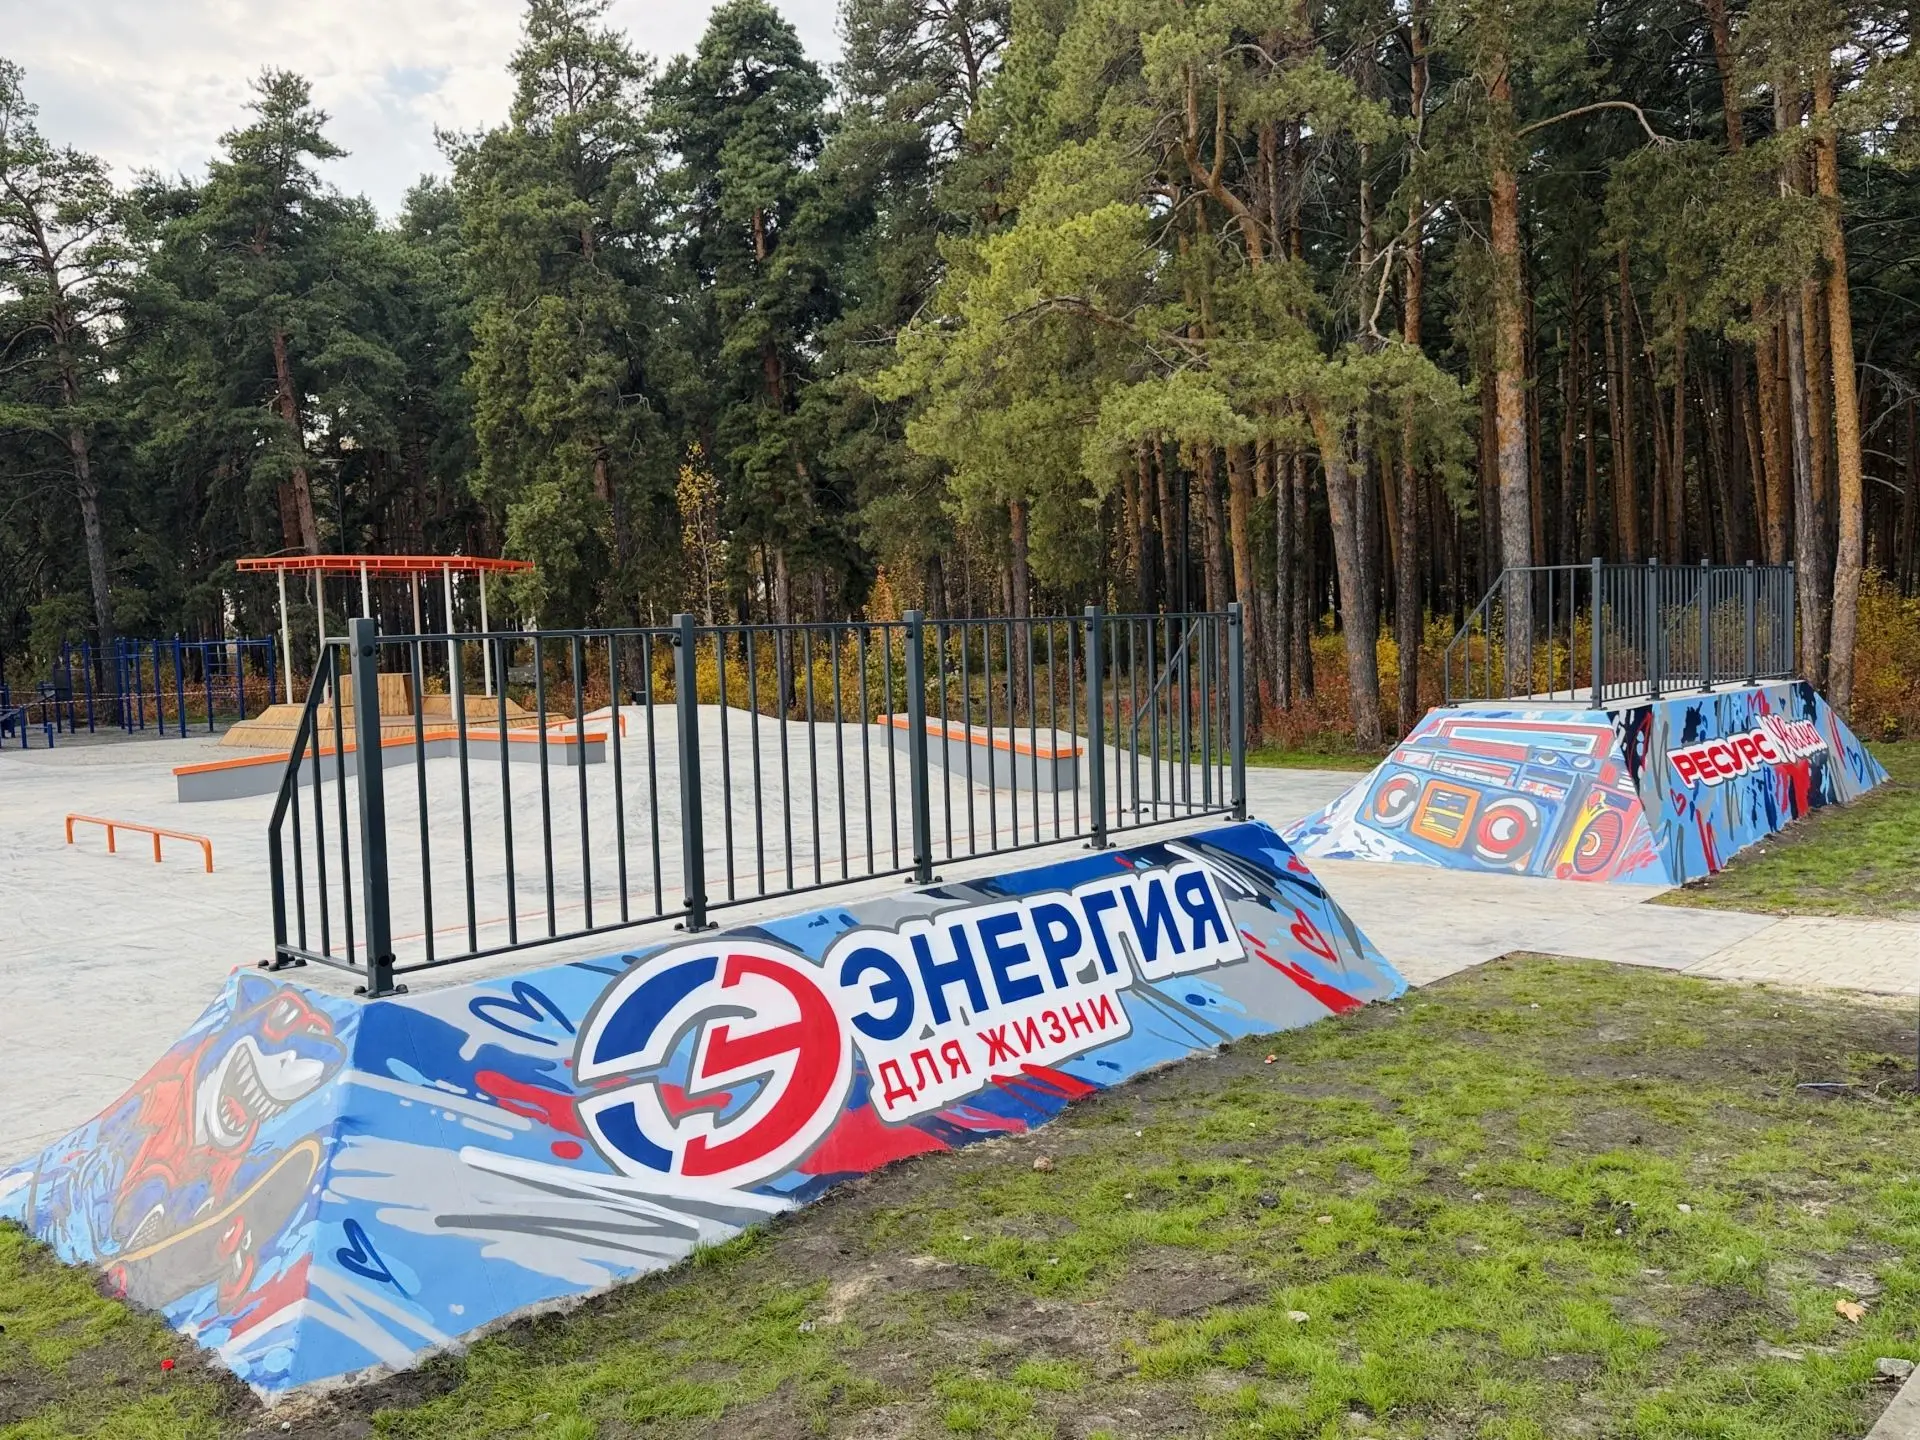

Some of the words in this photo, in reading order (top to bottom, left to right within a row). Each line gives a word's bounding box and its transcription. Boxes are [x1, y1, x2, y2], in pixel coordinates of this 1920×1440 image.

[1672, 734, 1776, 784] РЕСУРС
[840, 871, 1228, 1040] ЭНЕРГИЯ
[877, 1040, 970, 1110] ДЛЯ
[978, 994, 1118, 1066] ЖИЗНИ
